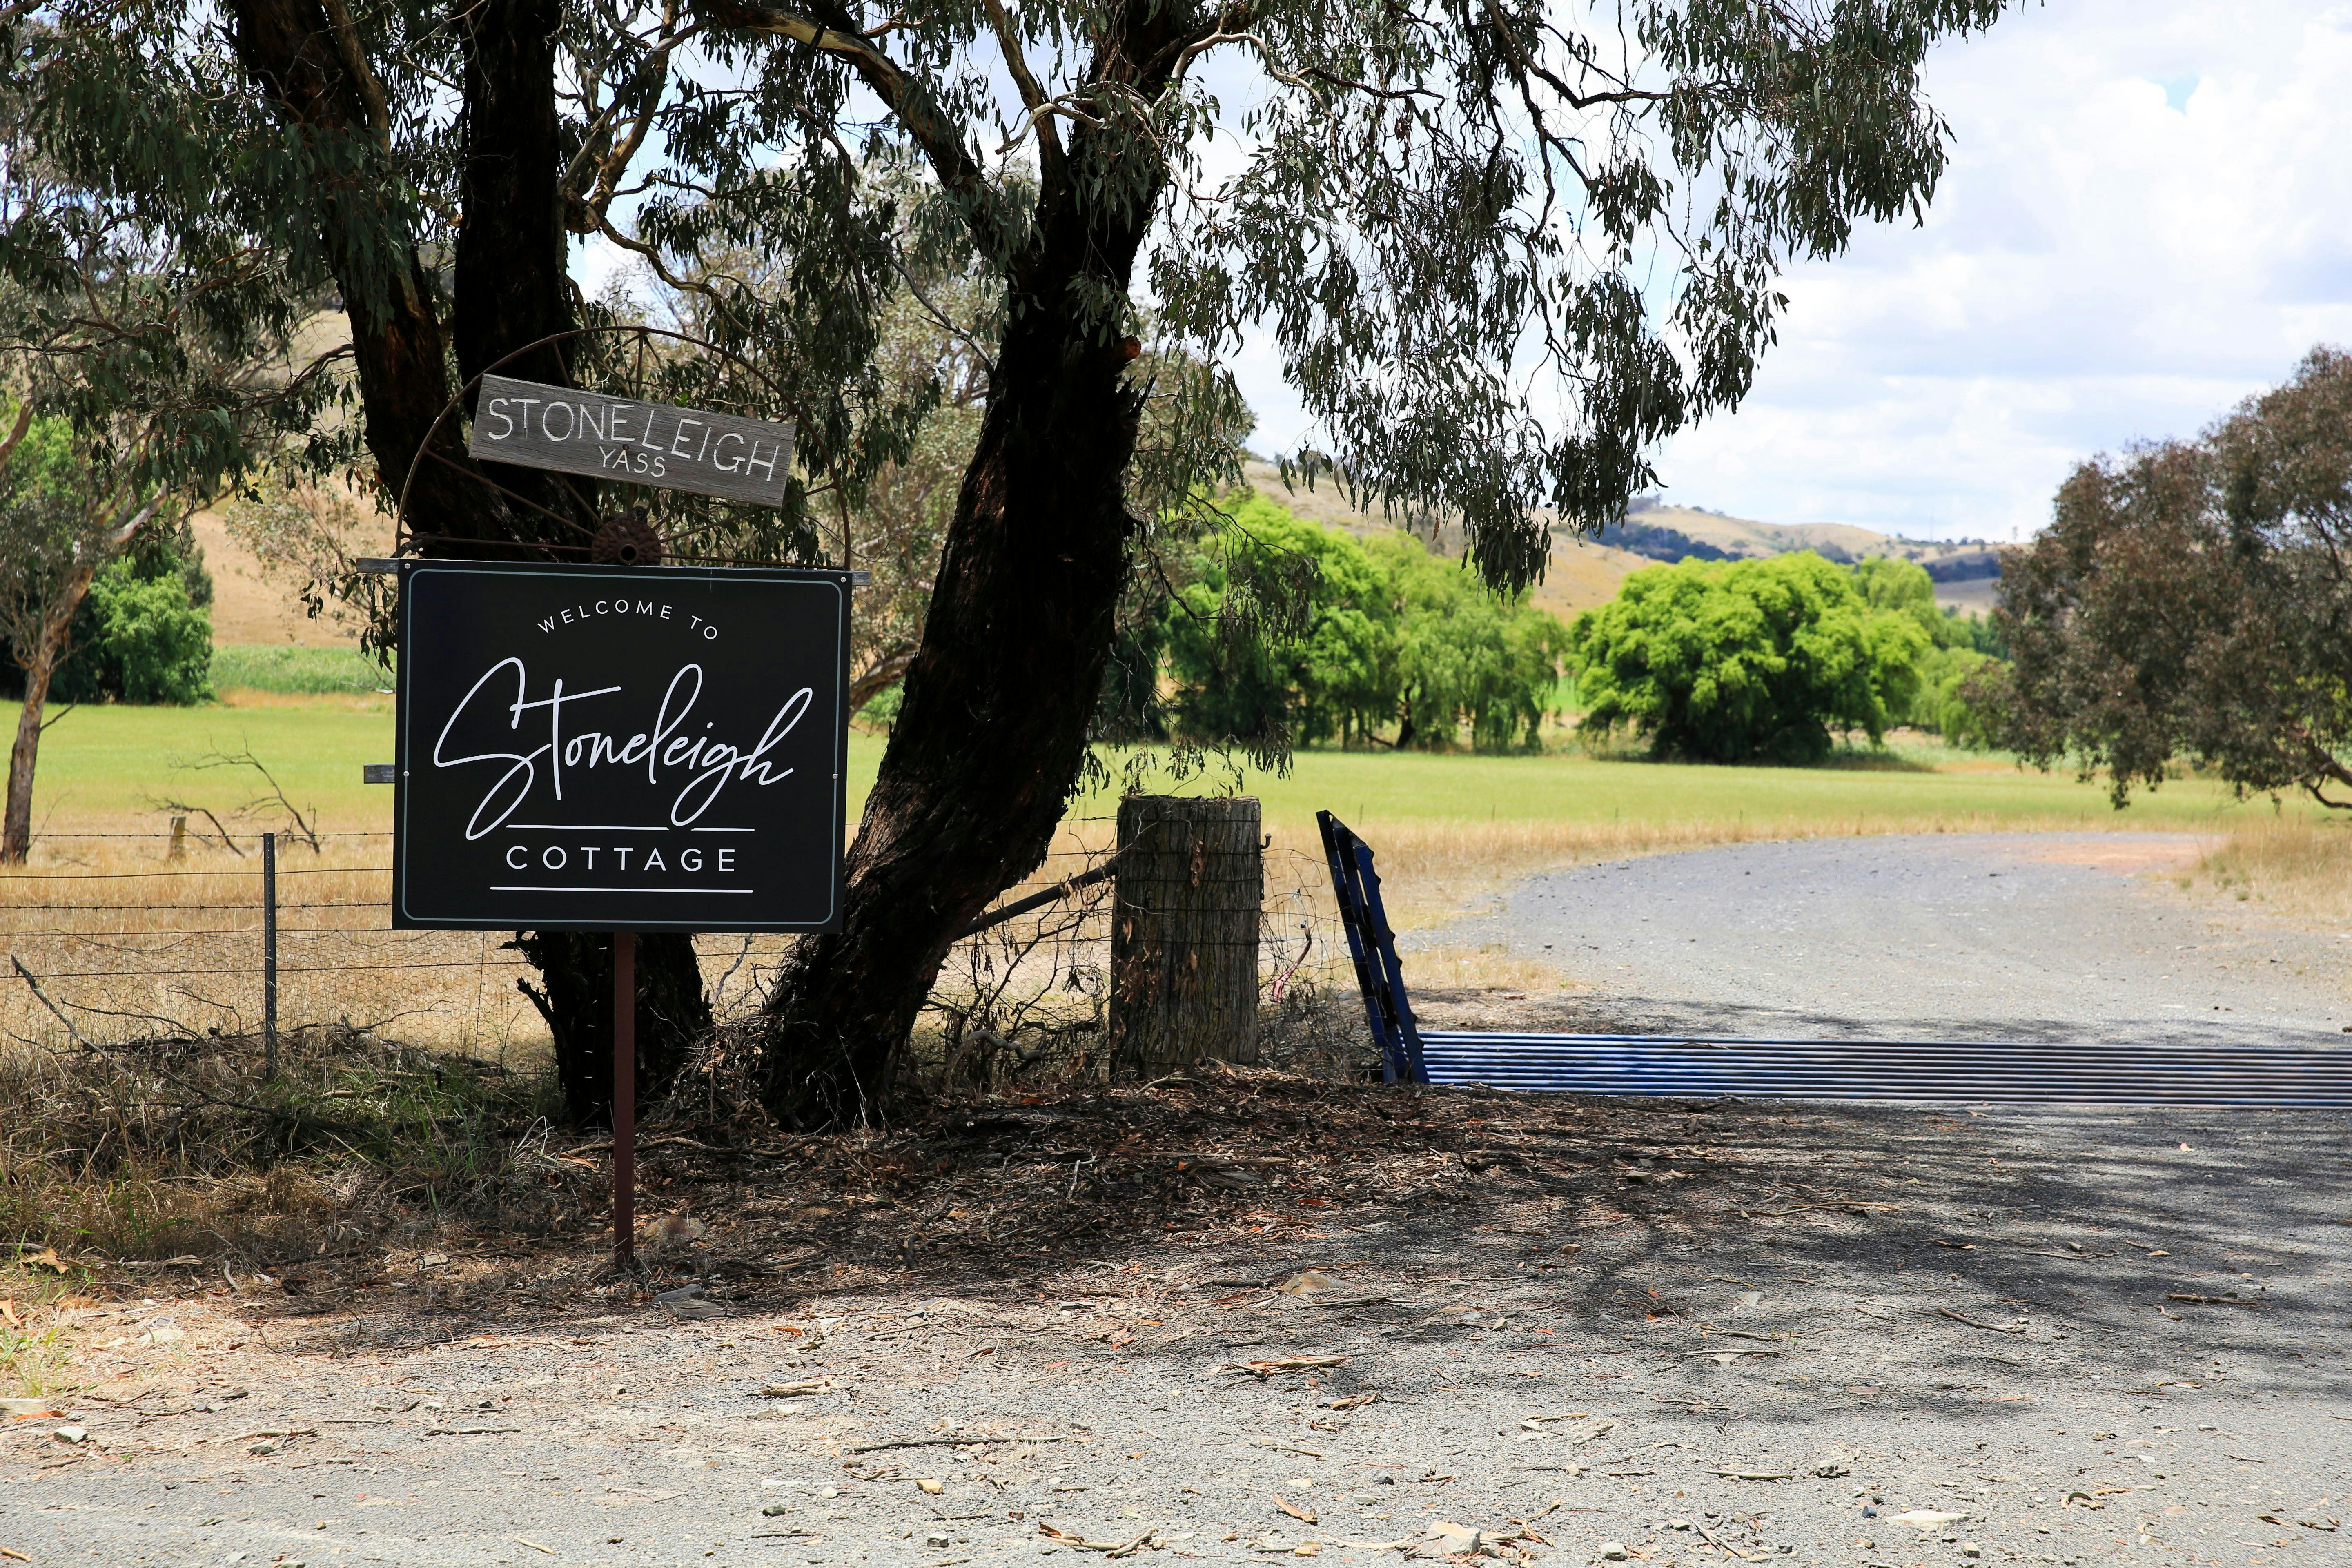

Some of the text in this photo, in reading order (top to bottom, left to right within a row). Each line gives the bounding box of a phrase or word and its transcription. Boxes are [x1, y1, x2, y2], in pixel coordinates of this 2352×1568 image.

[488, 397, 780, 482] STONELEIGH
[599, 445, 665, 477] YASS
[537, 599, 718, 639] WELCOME TO
[433, 657, 813, 840] Stoneleigh
[506, 846, 735, 872] COTTAGE
